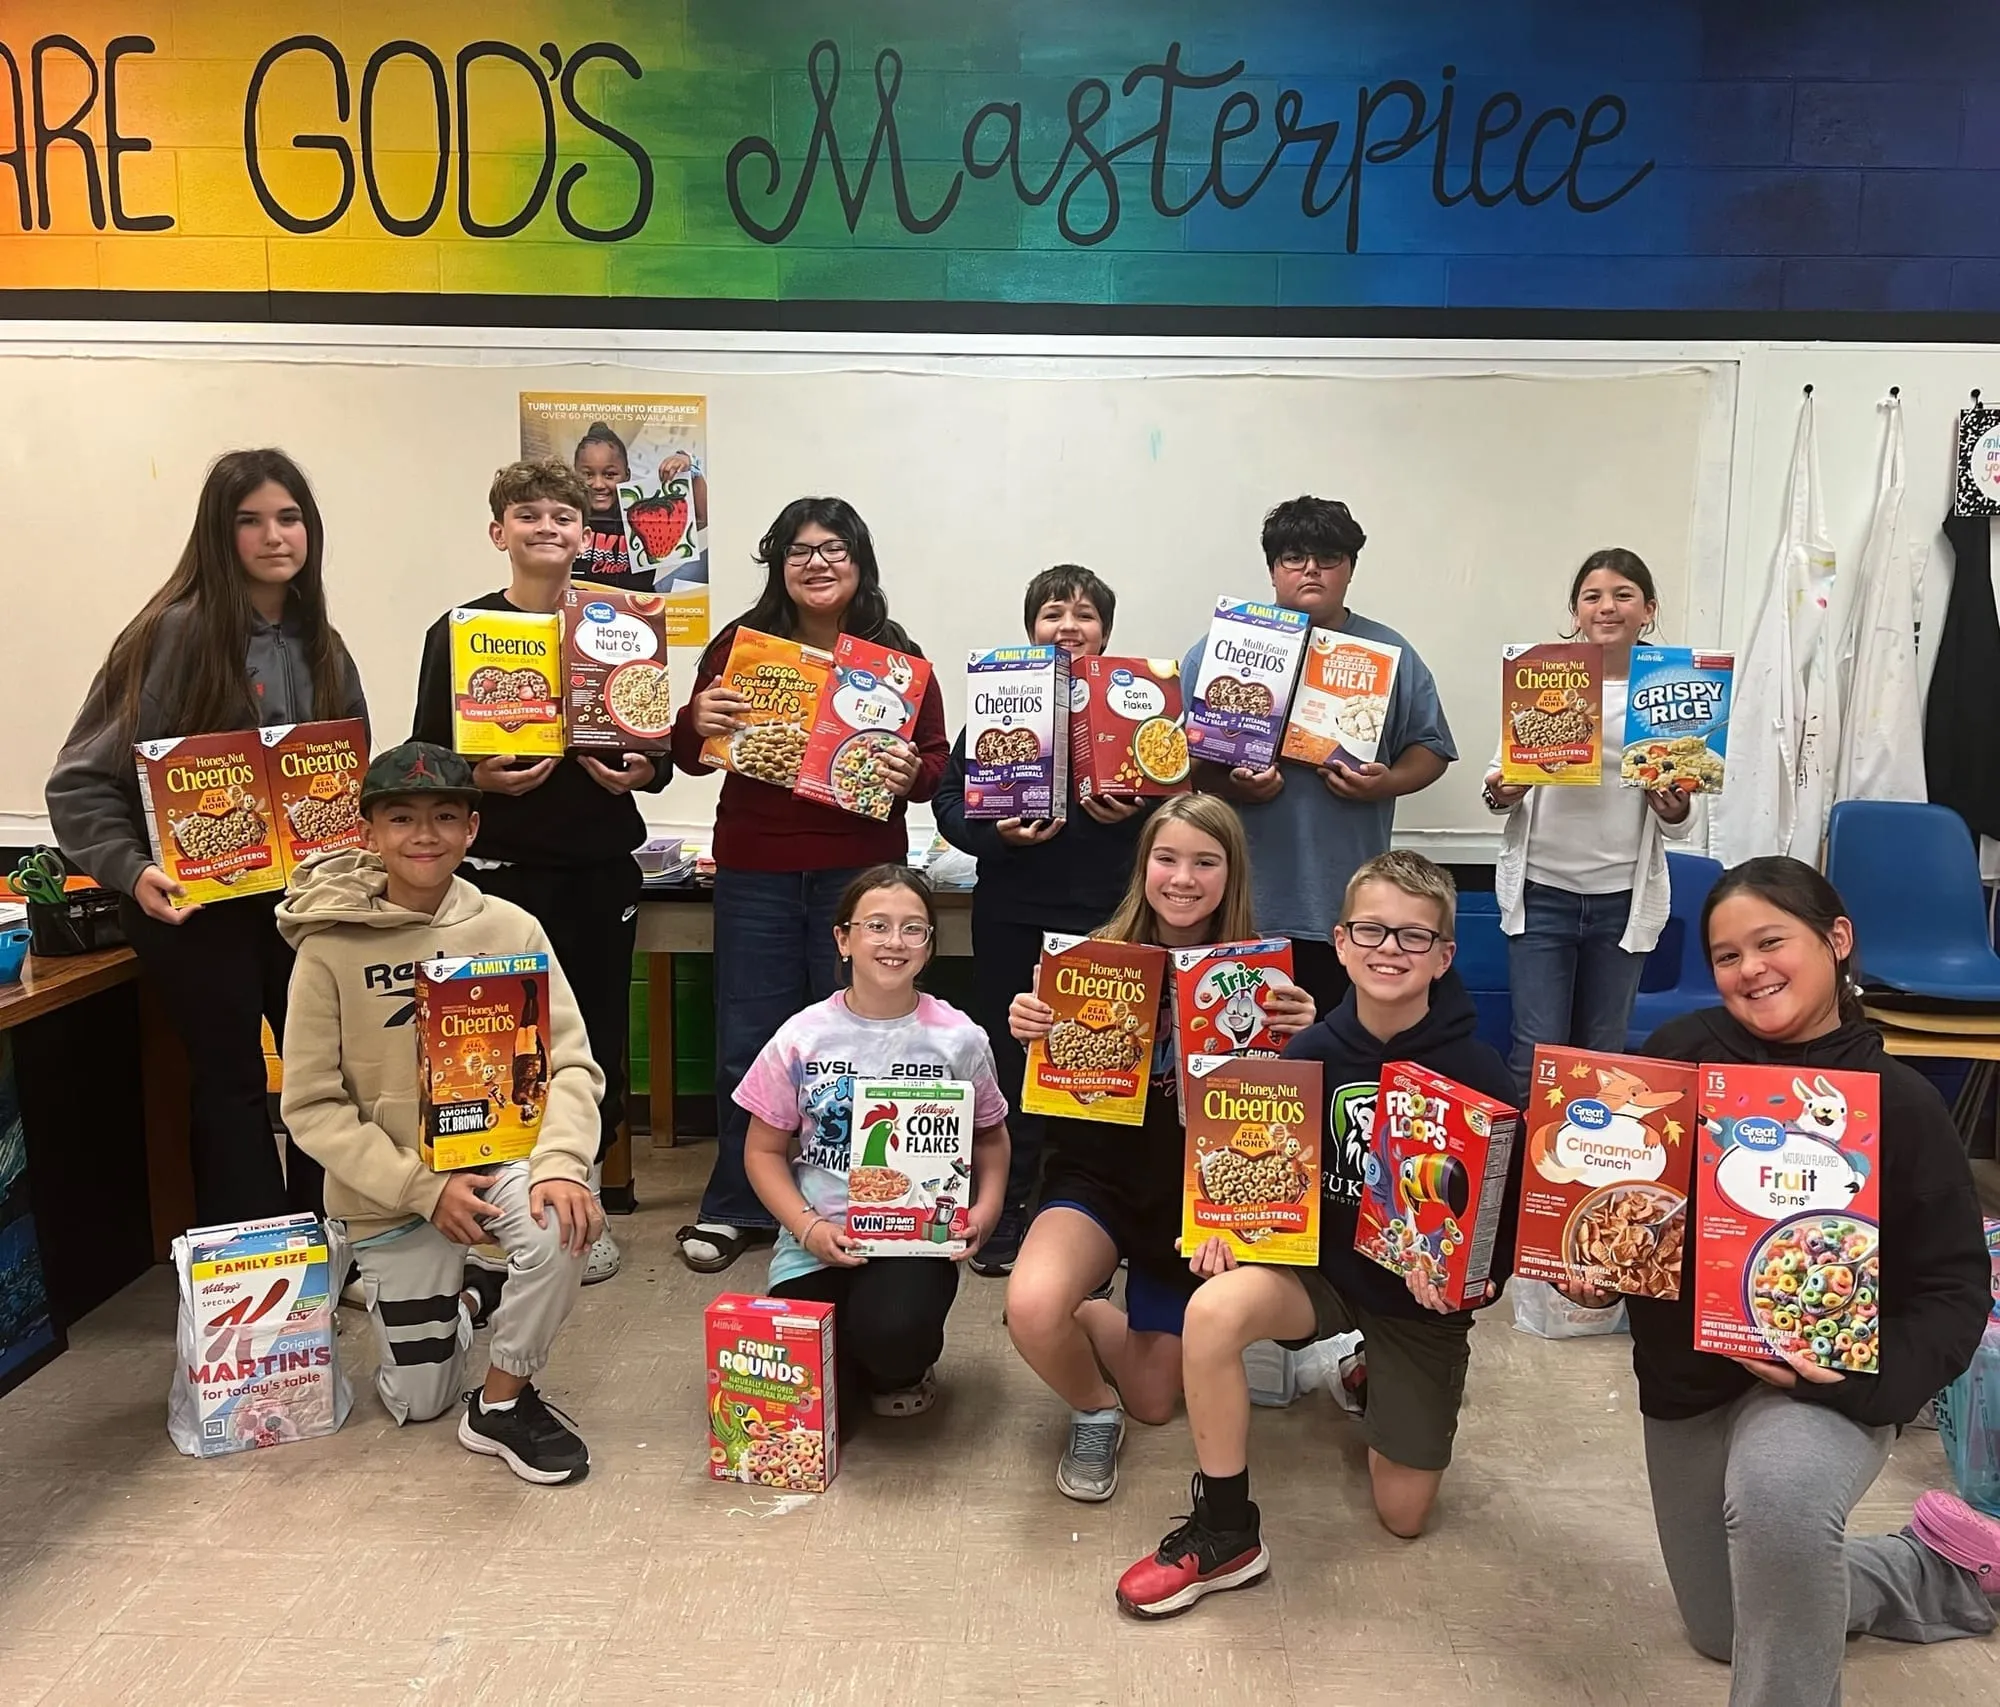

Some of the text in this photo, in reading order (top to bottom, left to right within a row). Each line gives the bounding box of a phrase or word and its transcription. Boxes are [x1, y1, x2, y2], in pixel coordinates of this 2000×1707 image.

[244, 34, 654, 243] GOD'S
[725, 38, 1656, 254] Masterpiece
[527, 402, 551, 411] TURN
[553, 403, 577, 411] YOUR
[579, 403, 623, 412] ARTWORK
[624, 404, 645, 412] INTO
[568, 412, 581, 420] 60
[583, 413, 633, 421] PRODUCTS
[635, 414, 684, 422] AVAILABLE
[1246, 603, 1300, 624] FAMILY SIZE
[596, 626, 638, 641] Honey
[469, 633, 546, 656] Cheerios
[595, 639, 641, 652] Nut O's
[1242, 638, 1289, 657] Multi Grain
[995, 648, 1046, 662] FAMILY SIZE
[1214, 639, 1286, 673] Cheerios
[1330, 653, 1372, 664] FROSTED
[757, 666, 799, 678] cocoa
[1323, 659, 1378, 673] SHREDDED
[1542, 661, 1585, 672] Honey Nut
[733, 674, 817, 692] Peanut Butter
[1321, 666, 1378, 692] WHEAT
[1515, 667, 1590, 689] Cheerios
[998, 684, 1043, 696] Multi Grain
[1125, 690, 1148, 699] Corn
[1633, 682, 1723, 709] CRISPY
[742, 685, 800, 713] Puffs
[975, 693, 1042, 714] Cheerios
[1123, 700, 1152, 710] Flakes
[465, 707, 544, 717] LOWER CHOLESTEROL
[855, 698, 887, 719] Fruit
[1651, 701, 1712, 725] RICE
[306, 740, 350, 754] Honey Nut
[1538, 749, 1588, 759] CHOLESTEROL
[196, 753, 245, 768] Honey Nut
[280, 751, 358, 777] Cheerios
[166, 765, 254, 793] Cheerios
[202, 801, 231, 810] HONEY
[205, 795, 226, 804] REAL
[294, 845, 323, 856] LOWER
[180, 852, 268, 876] LOWER CHOLESTEROL
[470, 959, 511, 976] FAMILY
[513, 957, 537, 971] SIZE
[1090, 962, 1142, 979] Honey Nut
[1056, 968, 1146, 1003] Cheerios
[1211, 962, 1264, 998] Trix
[467, 1004, 509, 1017] Honey Nut
[1087, 1006, 1108, 1014] REAL
[441, 1014, 515, 1037] Cheerios
[1081, 1014, 1112, 1022] HONEY
[805, 1061, 944, 1078] SVSL 2025
[1539, 1064, 1557, 1078] 14
[1040, 1073, 1134, 1088] LOWER CHOLESTEROL
[1707, 1076, 1726, 1090] 15
[1240, 1082, 1275, 1099] Honey
[1277, 1084, 1298, 1097] Nut
[439, 1106, 483, 1118] AMON-RA
[913, 1102, 955, 1117] Kellogg's
[1204, 1090, 1305, 1124] Cheerios
[1385, 1090, 1450, 1125] FROOT
[1572, 1105, 1605, 1119] Great
[906, 1116, 960, 1137] CORN
[1579, 1115, 1604, 1125] Value
[1241, 1131, 1266, 1140] REAL
[1390, 1115, 1448, 1151] LOOPS
[1739, 1124, 1777, 1138] Great
[905, 1137, 960, 1154] FLAKES
[1235, 1140, 1270, 1149] HONEY
[1749, 1134, 1777, 1145] Value
[1566, 1137, 1652, 1161] Cinnamon
[1583, 1154, 1632, 1171] Crunch
[1782, 1151, 1839, 1167] NATURALLY FLAVORED
[1759, 1166, 1818, 1192] Fruit
[1197, 1210, 1302, 1222] LOWER CHOLESTEROL
[1233, 1204, 1268, 1213] CAN HELP
[852, 1215, 885, 1232] WIN
[896, 1216, 916, 1225] DAYS
[215, 1252, 308, 1275] FAMILY SIZE
[1519, 1267, 1531, 1275] NET
[202, 1282, 242, 1294] Kellogg's
[202, 1298, 236, 1308] SPECIAL
[1701, 1320, 1737, 1331] SWEETENED
[1701, 1328, 1766, 1343] WITH NATURAL FRUIT
[738, 1339, 786, 1361] FRUIT
[1723, 1341, 1738, 1350] 21.7
[1738, 1343, 1747, 1351] OZ
[188, 1346, 331, 1385] MARTIN'S
[719, 1350, 806, 1385] ROUNDS
[202, 1373, 321, 1400] for today's table
[729, 1376, 794, 1394] NATURALLY FLAVORED
